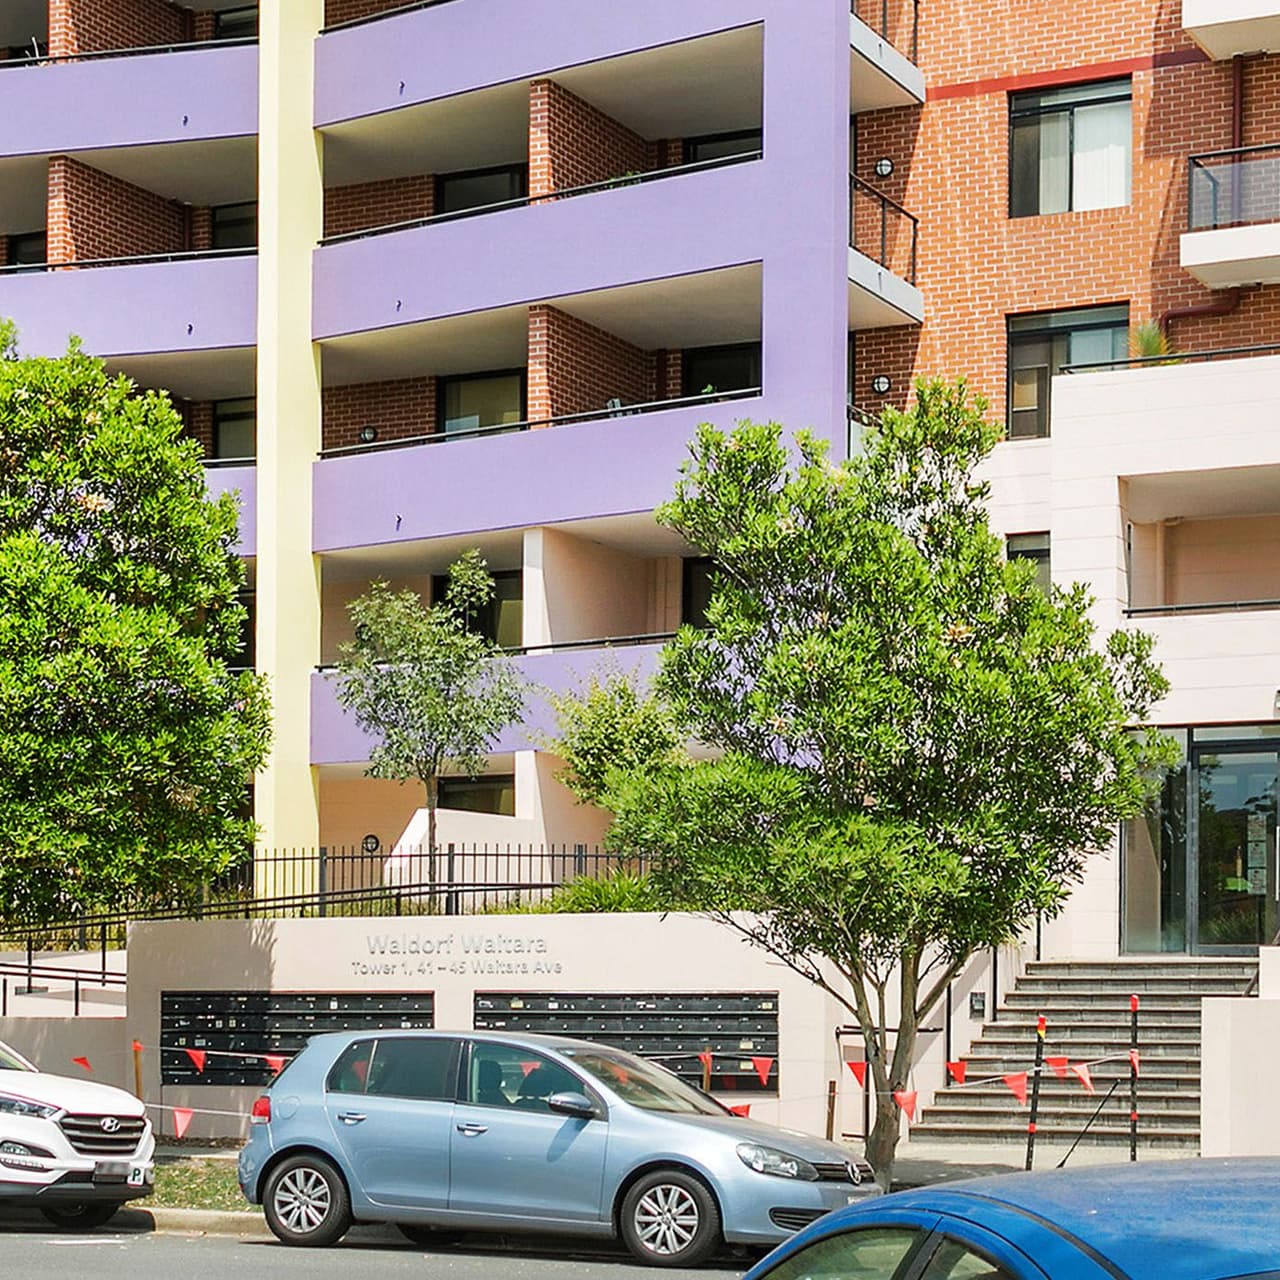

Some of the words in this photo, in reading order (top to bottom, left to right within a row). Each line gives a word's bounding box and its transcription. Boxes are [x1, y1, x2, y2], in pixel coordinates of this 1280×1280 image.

[366, 932, 454, 955] Waldorf
[461, 933, 548, 954] Waitara
[351, 960, 397, 976] Tower
[417, 962, 434, 975] 41
[470, 959, 529, 975] Waitara
[532, 960, 563, 975] Ave
[132, 1168, 141, 1182] P
